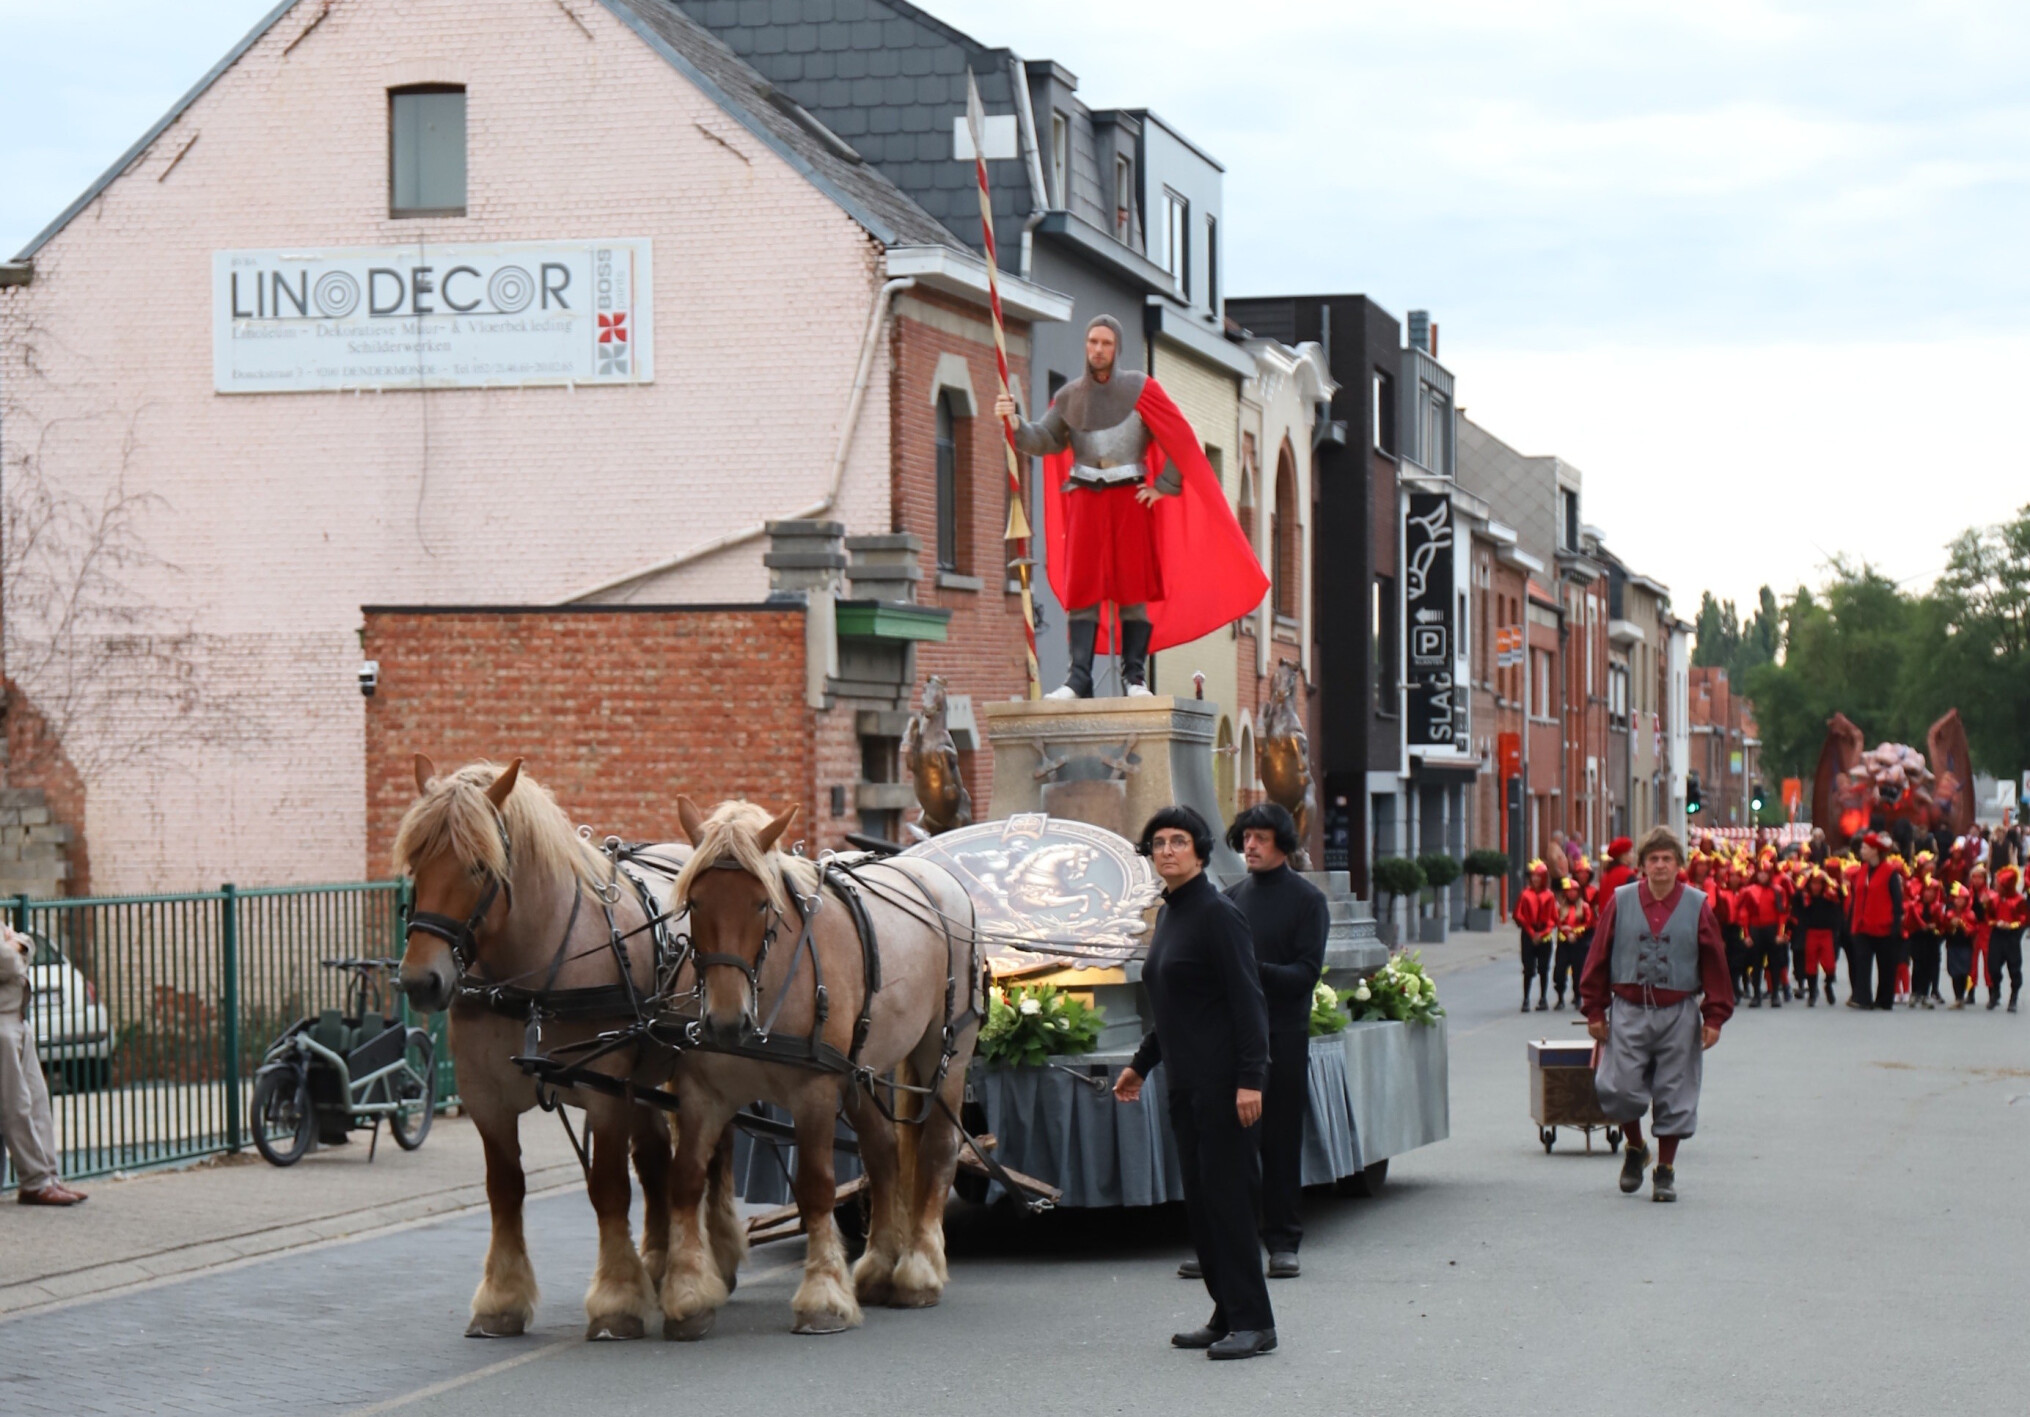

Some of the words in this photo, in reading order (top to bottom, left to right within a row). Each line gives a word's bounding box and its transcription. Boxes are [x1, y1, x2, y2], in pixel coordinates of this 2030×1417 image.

[231, 261, 572, 318] LINODECOR
[597, 249, 613, 309] BOSS
[316, 323, 397, 337] Dekoratieve
[468, 319, 573, 334] Vloerbekleding
[347, 340, 453, 354] Schilderwerken
[1421, 632, 1440, 655] P
